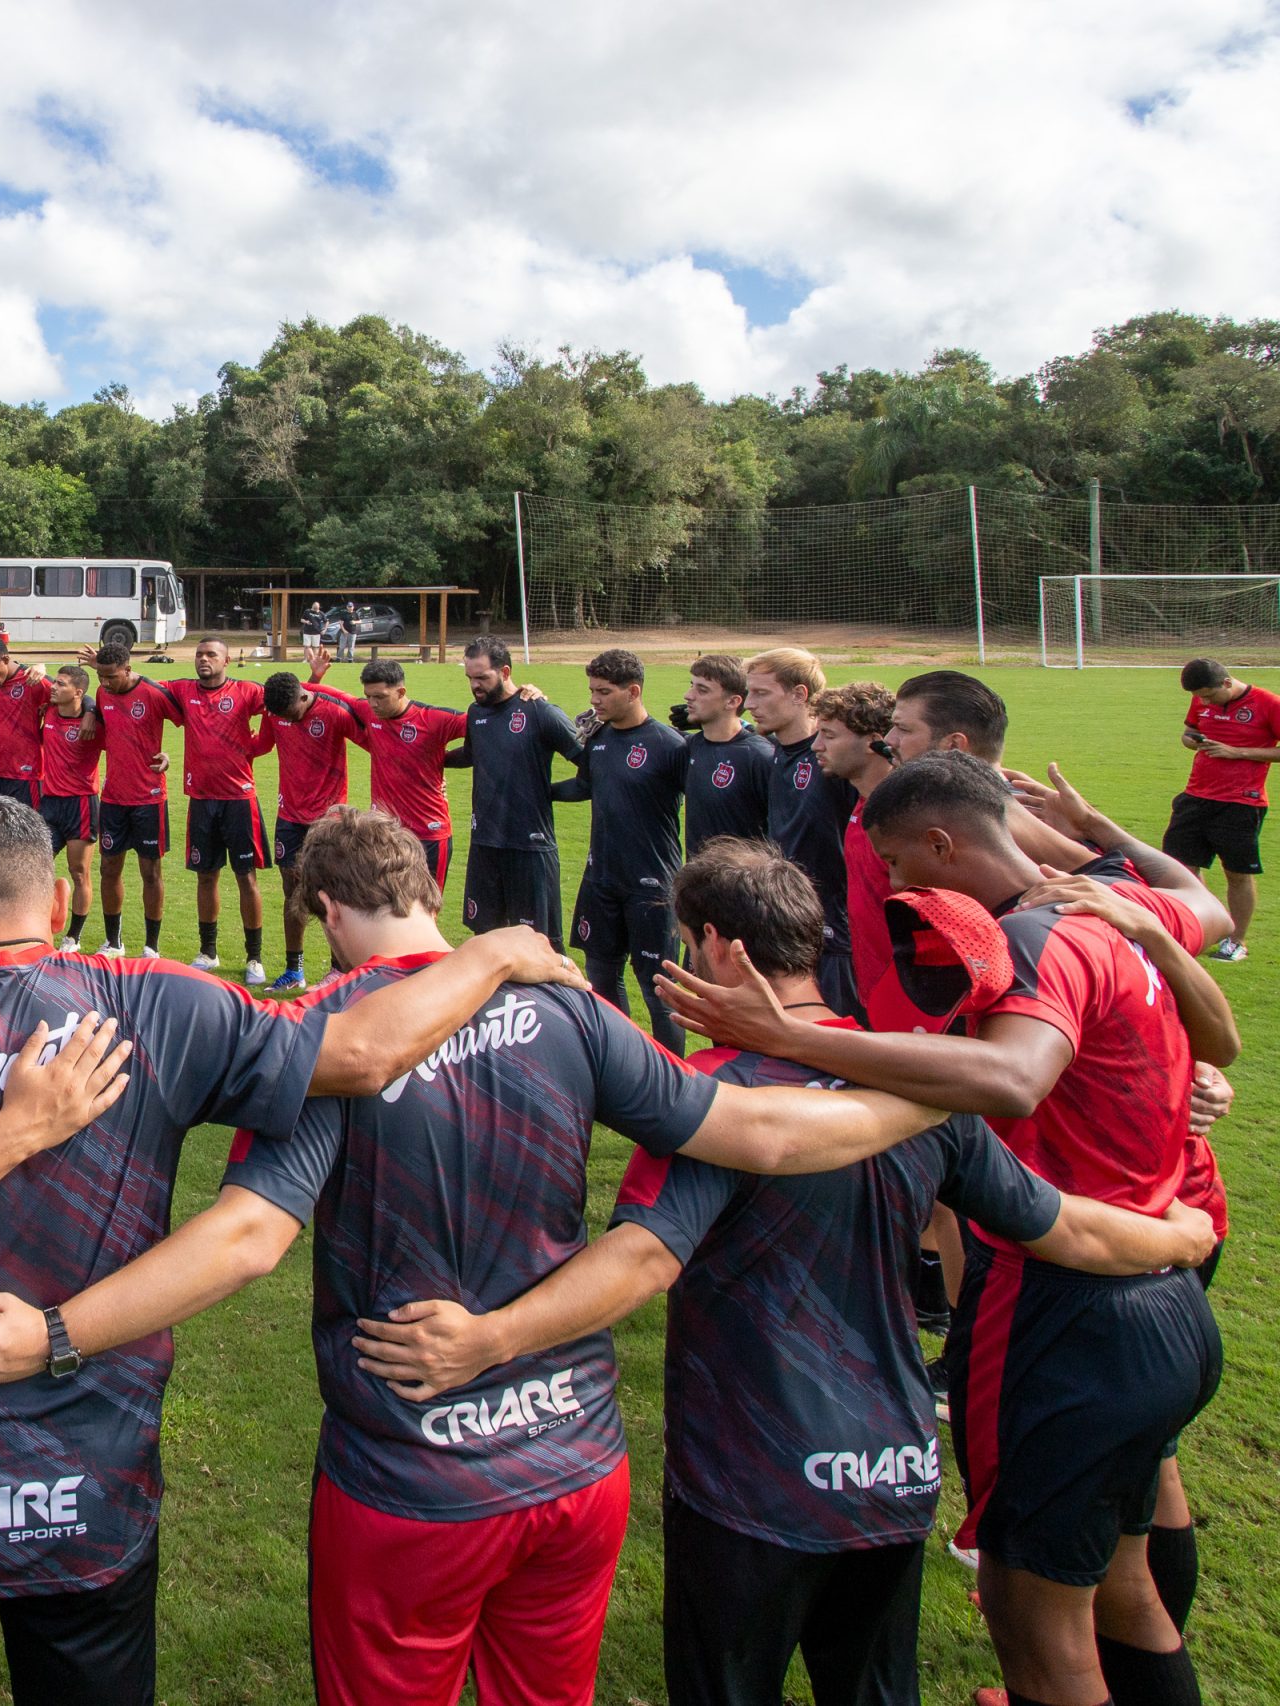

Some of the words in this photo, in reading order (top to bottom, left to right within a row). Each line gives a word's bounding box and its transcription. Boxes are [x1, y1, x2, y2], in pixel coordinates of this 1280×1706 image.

[421, 1368, 581, 1446] CRIARE
[804, 1437, 939, 1490] CRIARE
[8, 1522, 88, 1543] SPORTS
